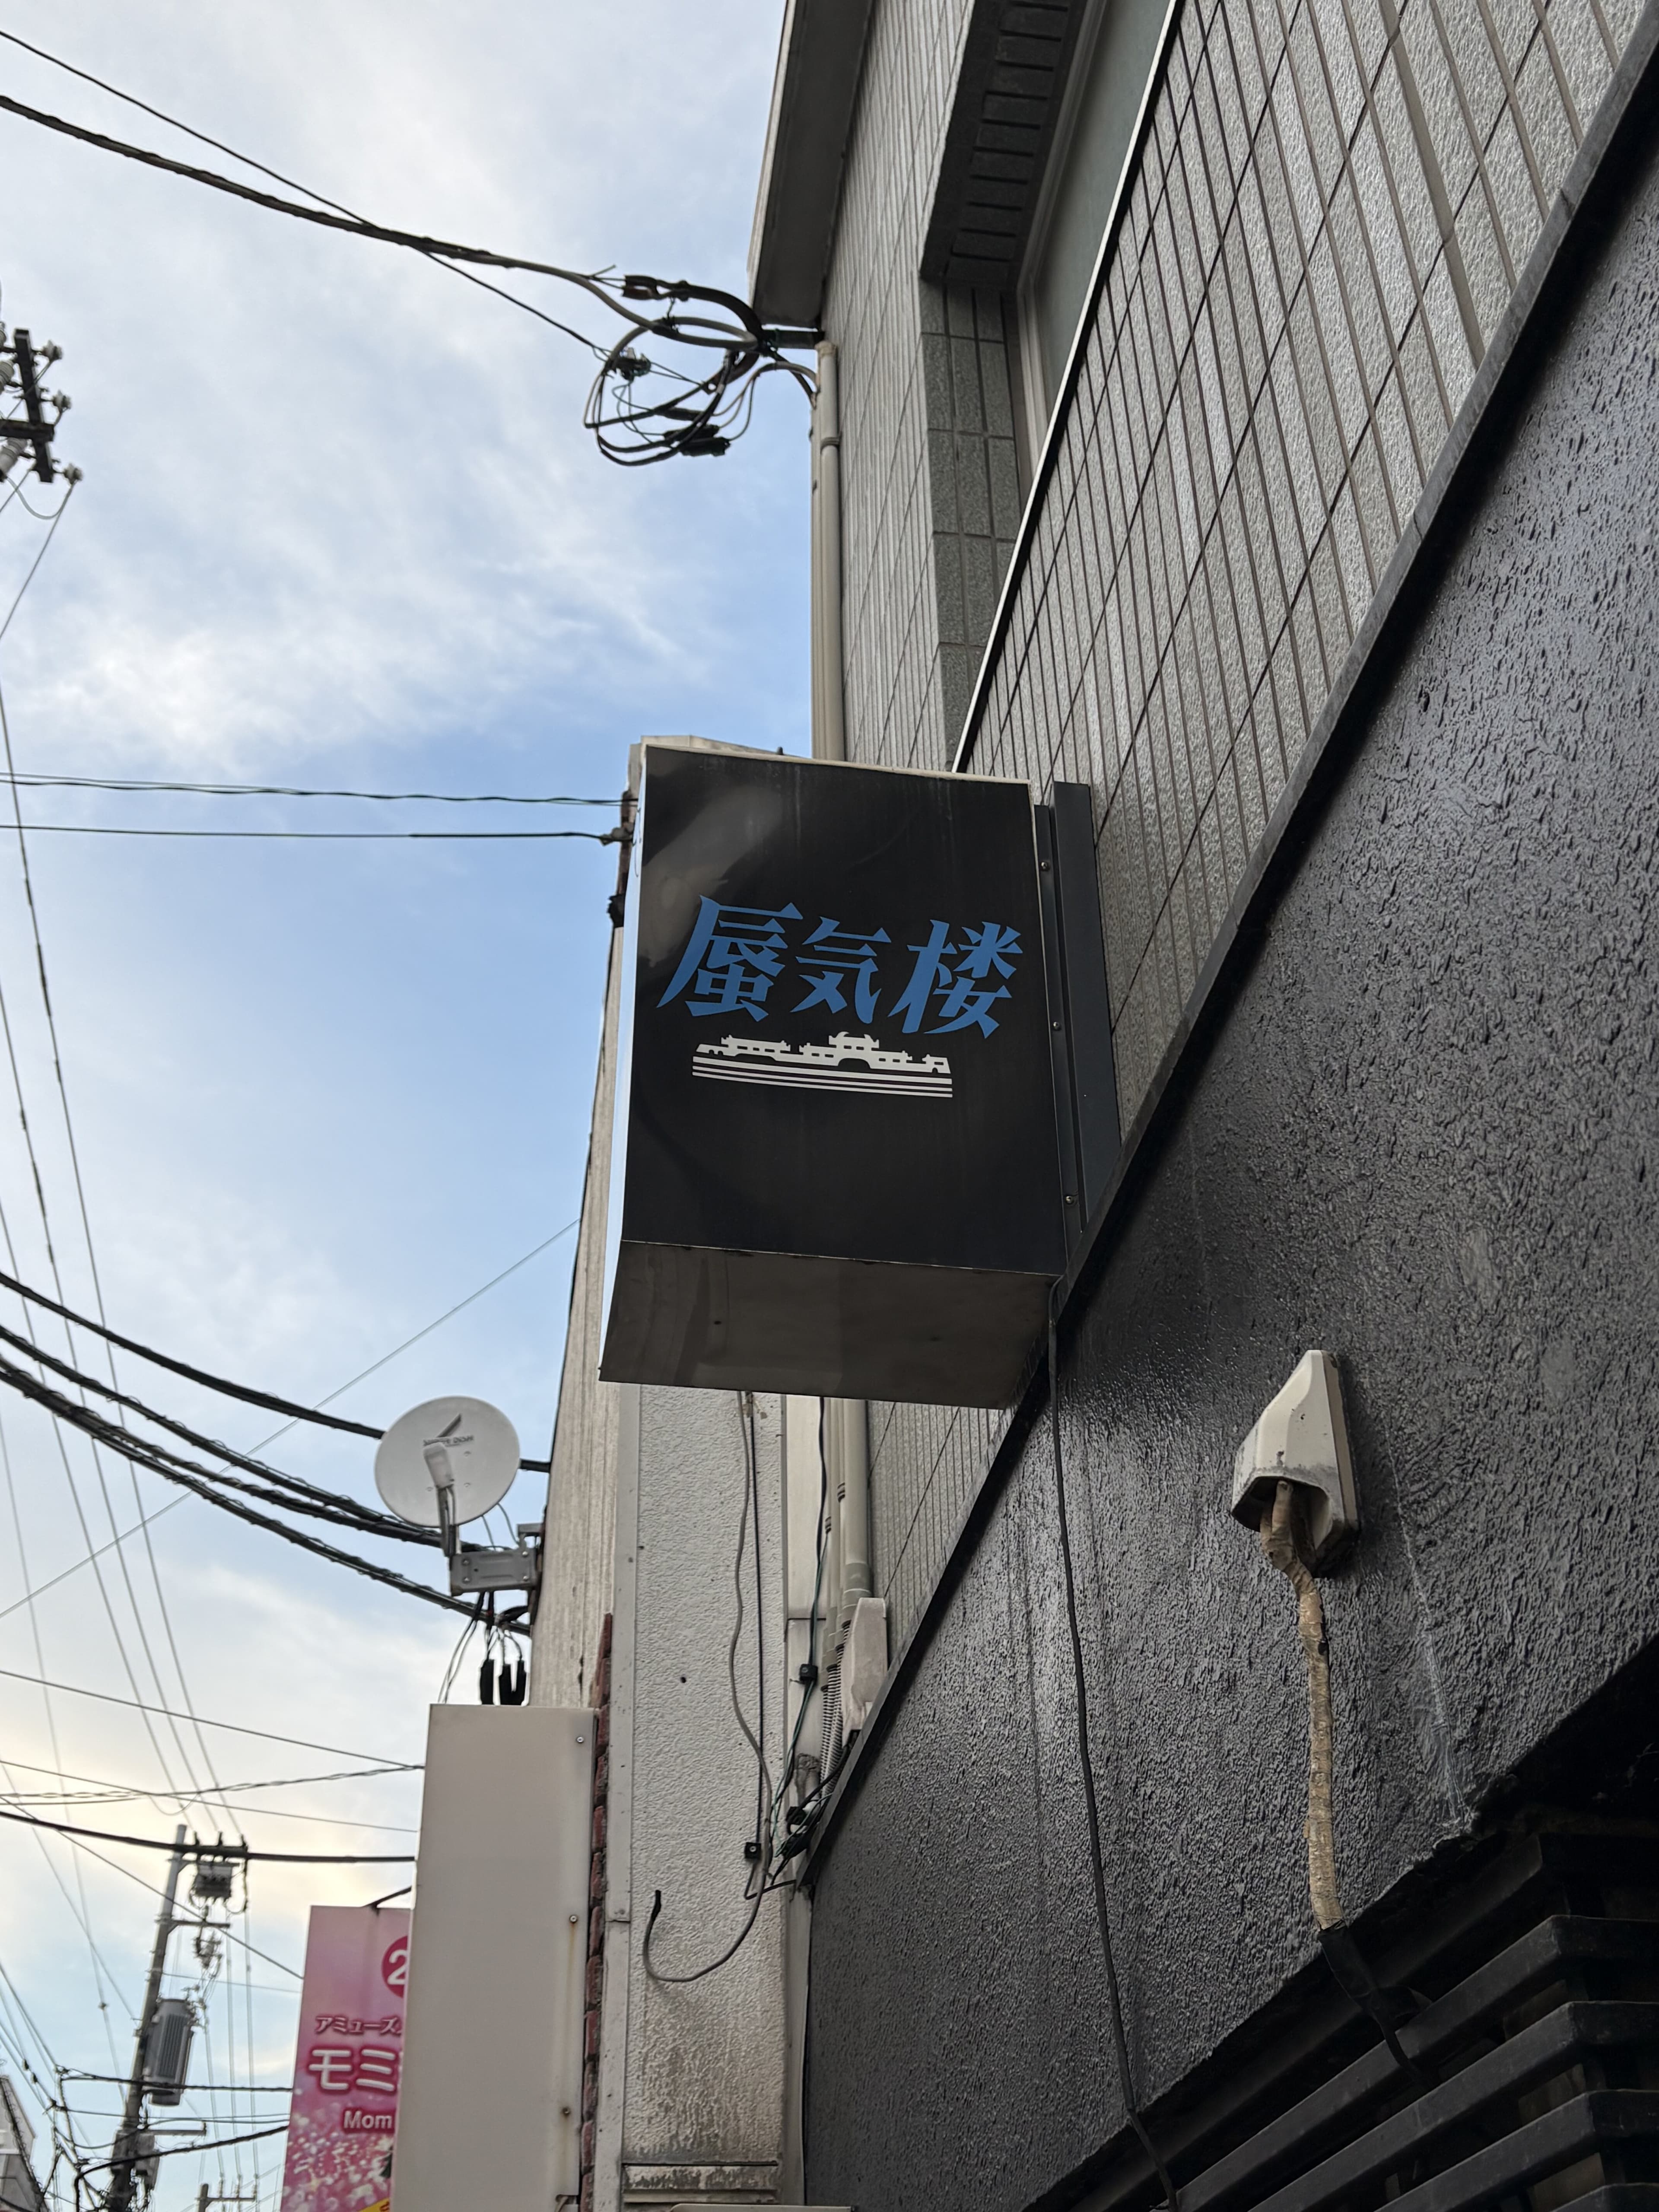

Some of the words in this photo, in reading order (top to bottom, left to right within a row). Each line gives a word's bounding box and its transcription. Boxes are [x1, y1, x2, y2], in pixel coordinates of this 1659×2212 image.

[656, 894, 1023, 1039] 蜃気楼
[315, 2016, 402, 2034] アミューズ
[308, 2049, 403, 2091] モミ
